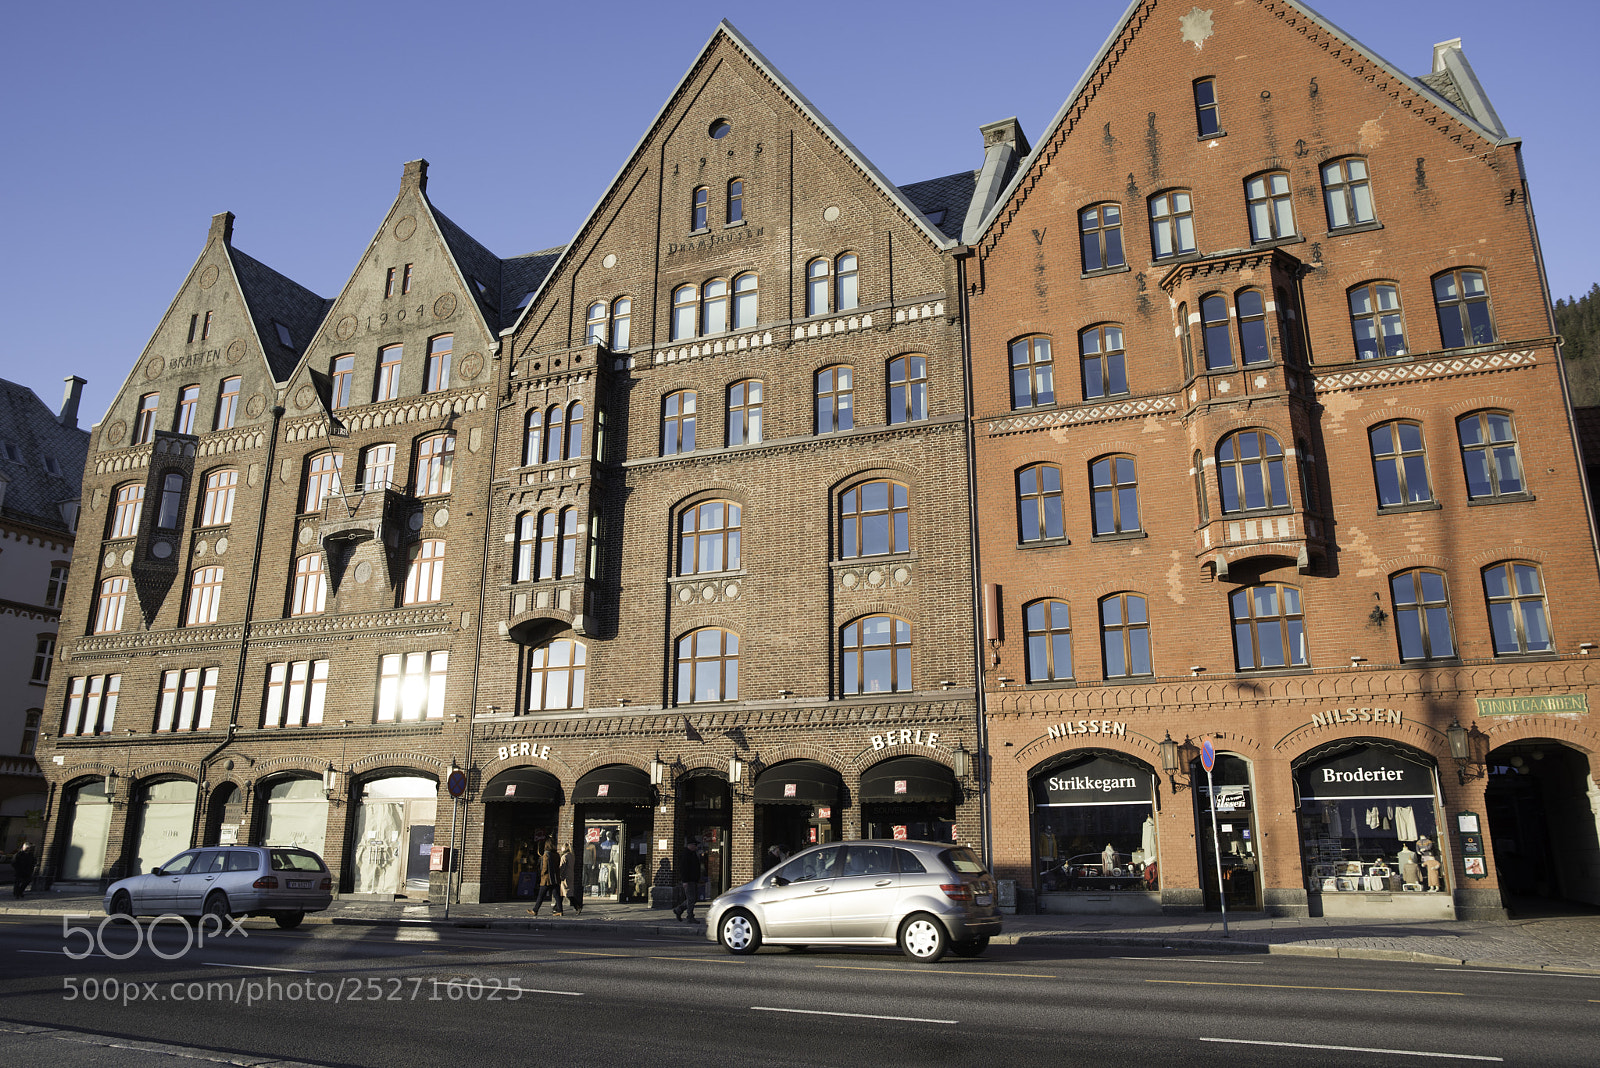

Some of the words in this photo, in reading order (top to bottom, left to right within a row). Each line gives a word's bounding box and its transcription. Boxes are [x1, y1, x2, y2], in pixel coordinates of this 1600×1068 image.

[673, 143, 763, 175] 1905
[366, 304, 424, 329] 1904
[1311, 707, 1402, 728] NILSSEN
[1047, 720, 1127, 739] NILSSEN
[871, 729, 939, 751] BERLE
[498, 742, 551, 761] BERLE
[1049, 776, 1137, 792] Strikkegarn
[1321, 766, 1404, 783] Broderier
